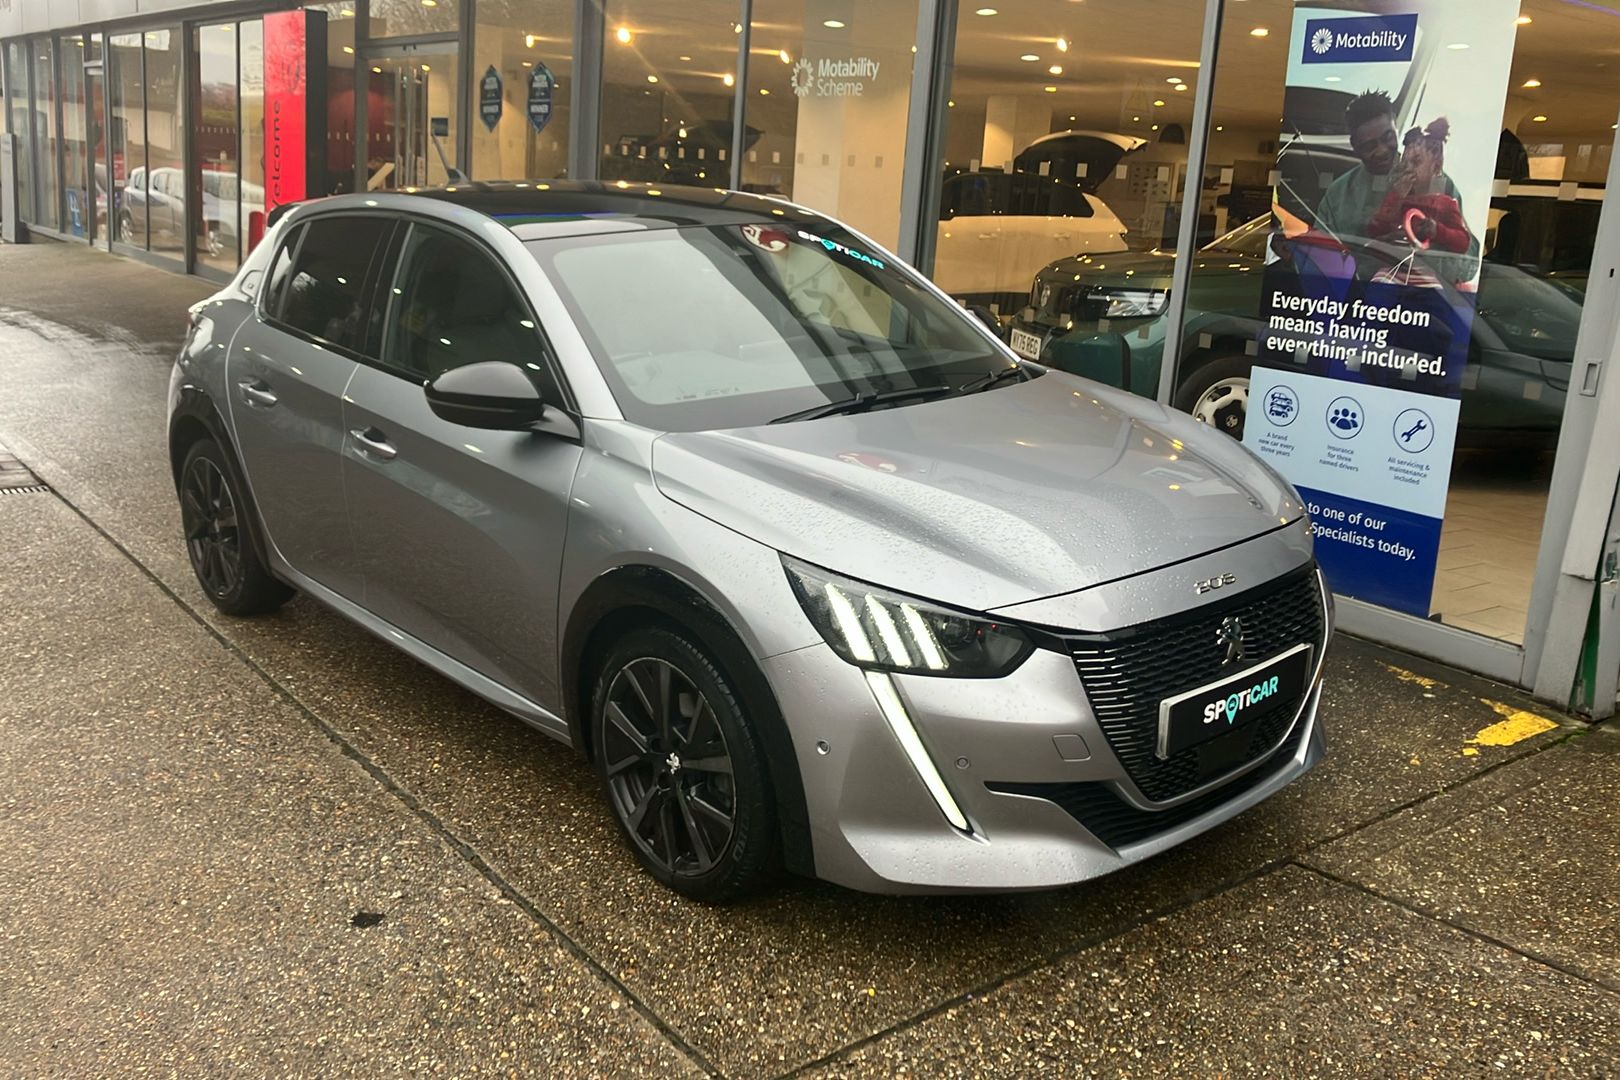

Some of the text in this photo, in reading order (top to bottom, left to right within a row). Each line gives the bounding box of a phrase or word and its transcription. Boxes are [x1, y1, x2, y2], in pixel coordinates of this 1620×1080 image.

[1335, 30, 1407, 51] Motability
[818, 57, 880, 81] Motability
[817, 78, 863, 97] Scheme
[272, 101, 281, 207] elcome
[1272, 291, 1431, 328] Everyday freedom
[1269, 315, 1389, 348] means having
[1361, 344, 1447, 376] included.
[1272, 432, 1288, 441] brand
[1261, 446, 1291, 457] three years
[1280, 443, 1295, 452] every
[1327, 451, 1352, 462] for three
[1319, 459, 1360, 472] named drivers
[1388, 456, 1397, 464] All
[1397, 458, 1424, 472] servicing
[1389, 465, 1428, 478] maintenance
[1394, 474, 1420, 486] included
[1308, 502, 1387, 531] to one of our
[1311, 522, 1416, 561] Specialists today.
